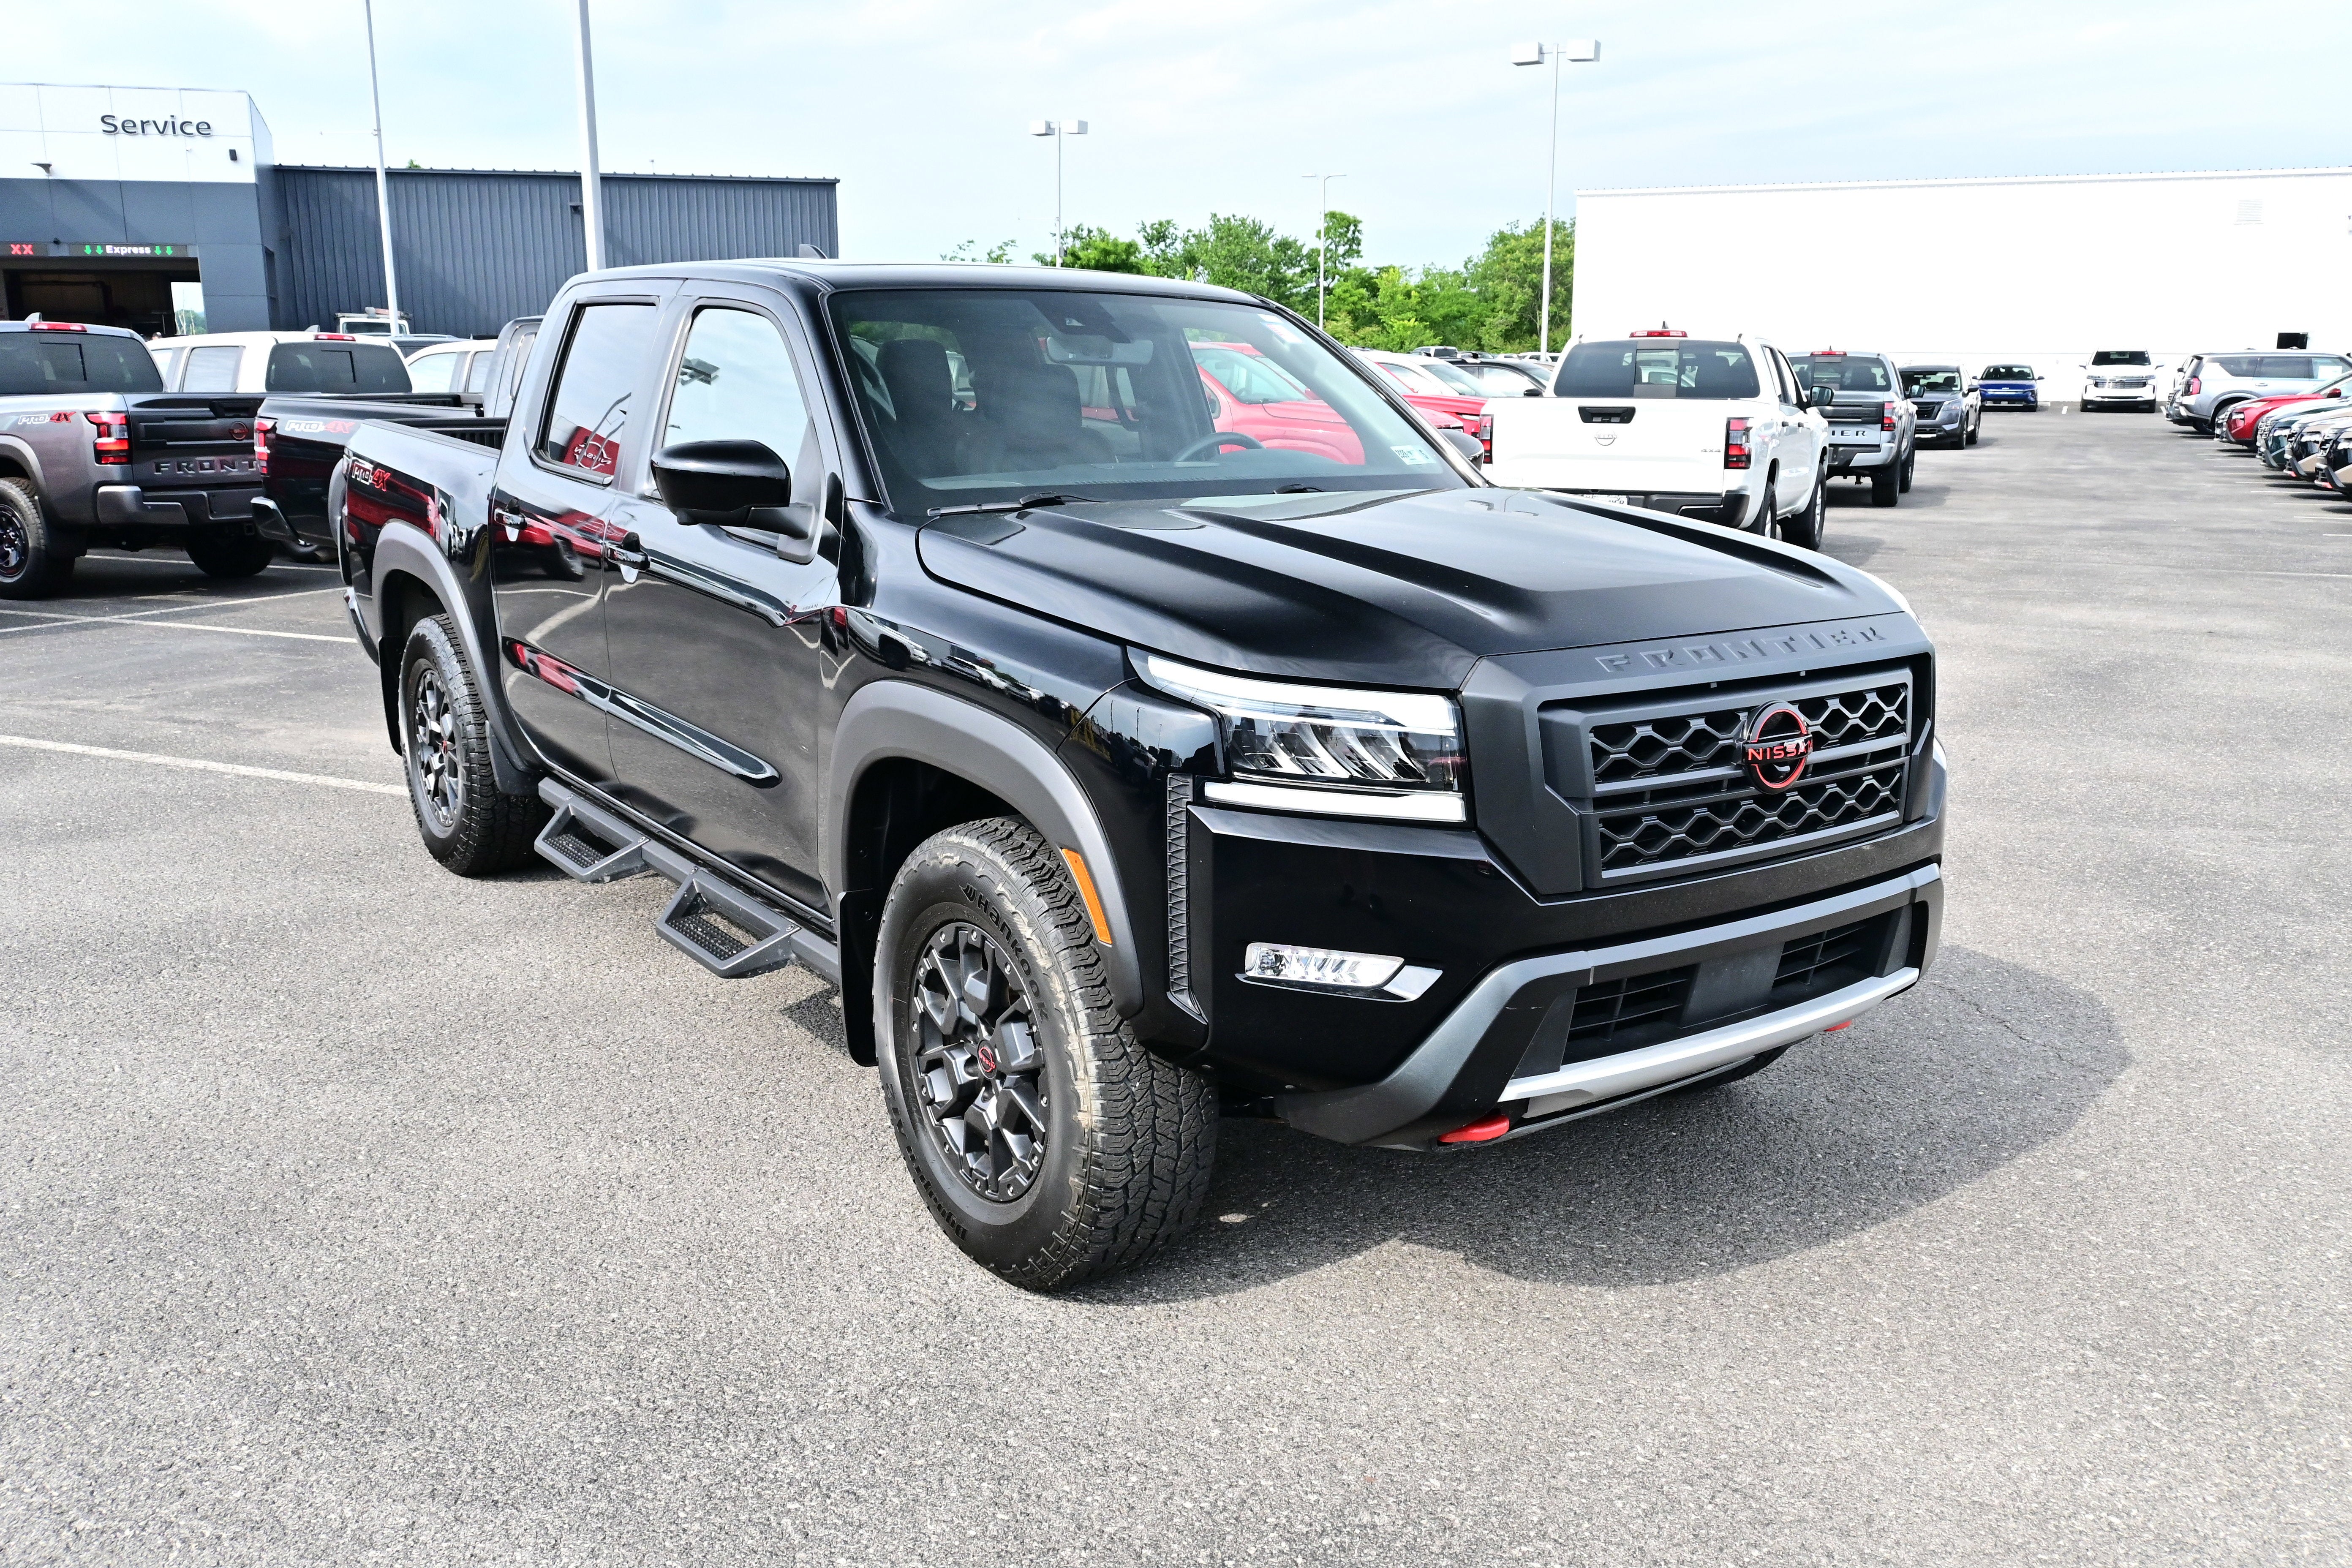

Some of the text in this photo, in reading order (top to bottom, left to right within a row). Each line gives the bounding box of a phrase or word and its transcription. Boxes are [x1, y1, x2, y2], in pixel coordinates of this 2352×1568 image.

[101, 114, 212, 136] Service
[105, 245, 151, 256] Express
[1594, 626, 1888, 672] FRONTIER
[1748, 740, 1812, 761] NISSAN
[977, 892, 1048, 1024] Hankook
